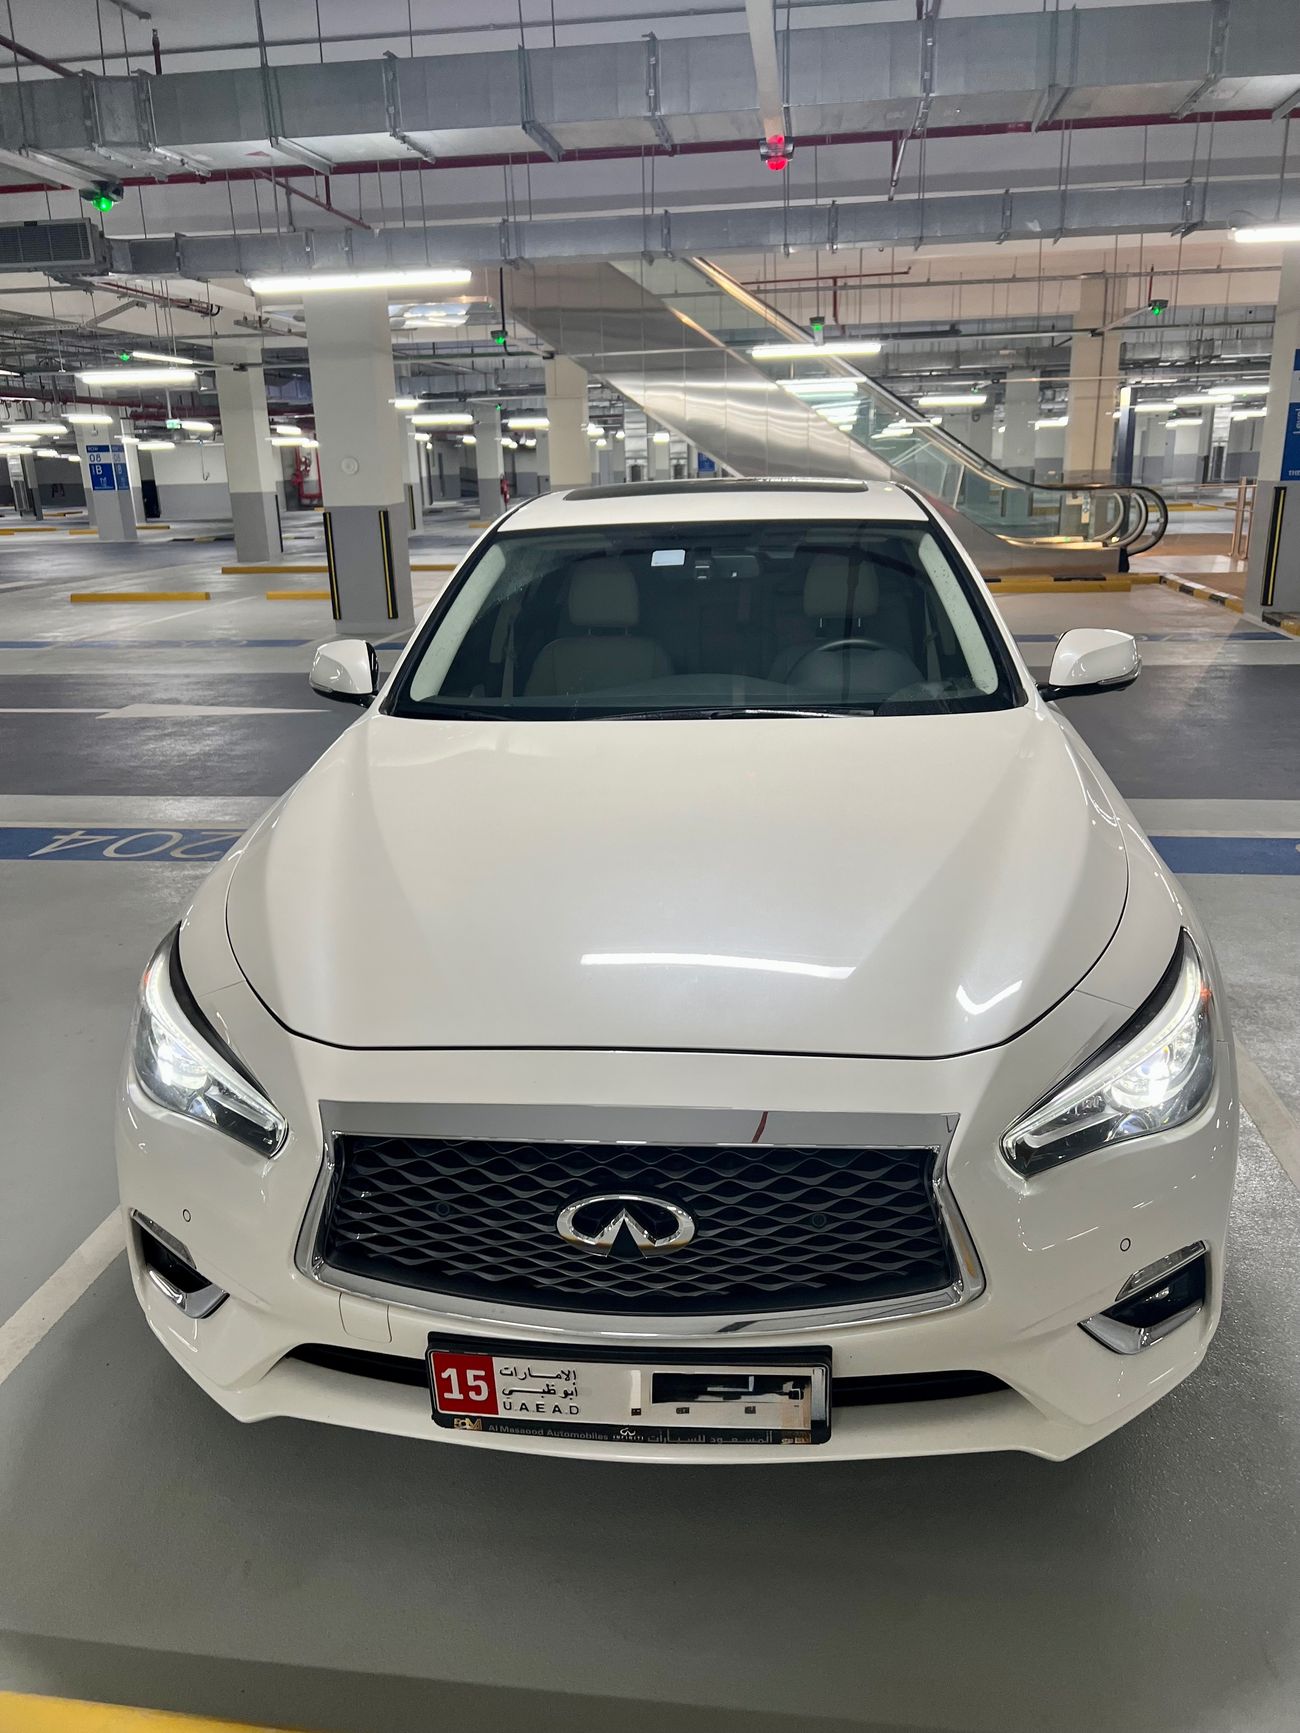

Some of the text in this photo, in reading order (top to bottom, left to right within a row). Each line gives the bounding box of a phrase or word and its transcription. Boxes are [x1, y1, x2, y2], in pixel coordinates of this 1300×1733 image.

[89, 453, 101, 462] 08
[441, 1367, 489, 1401] 15
[499, 1426, 544, 1436] Masaood
[547, 1430, 609, 1441] Automobiles
